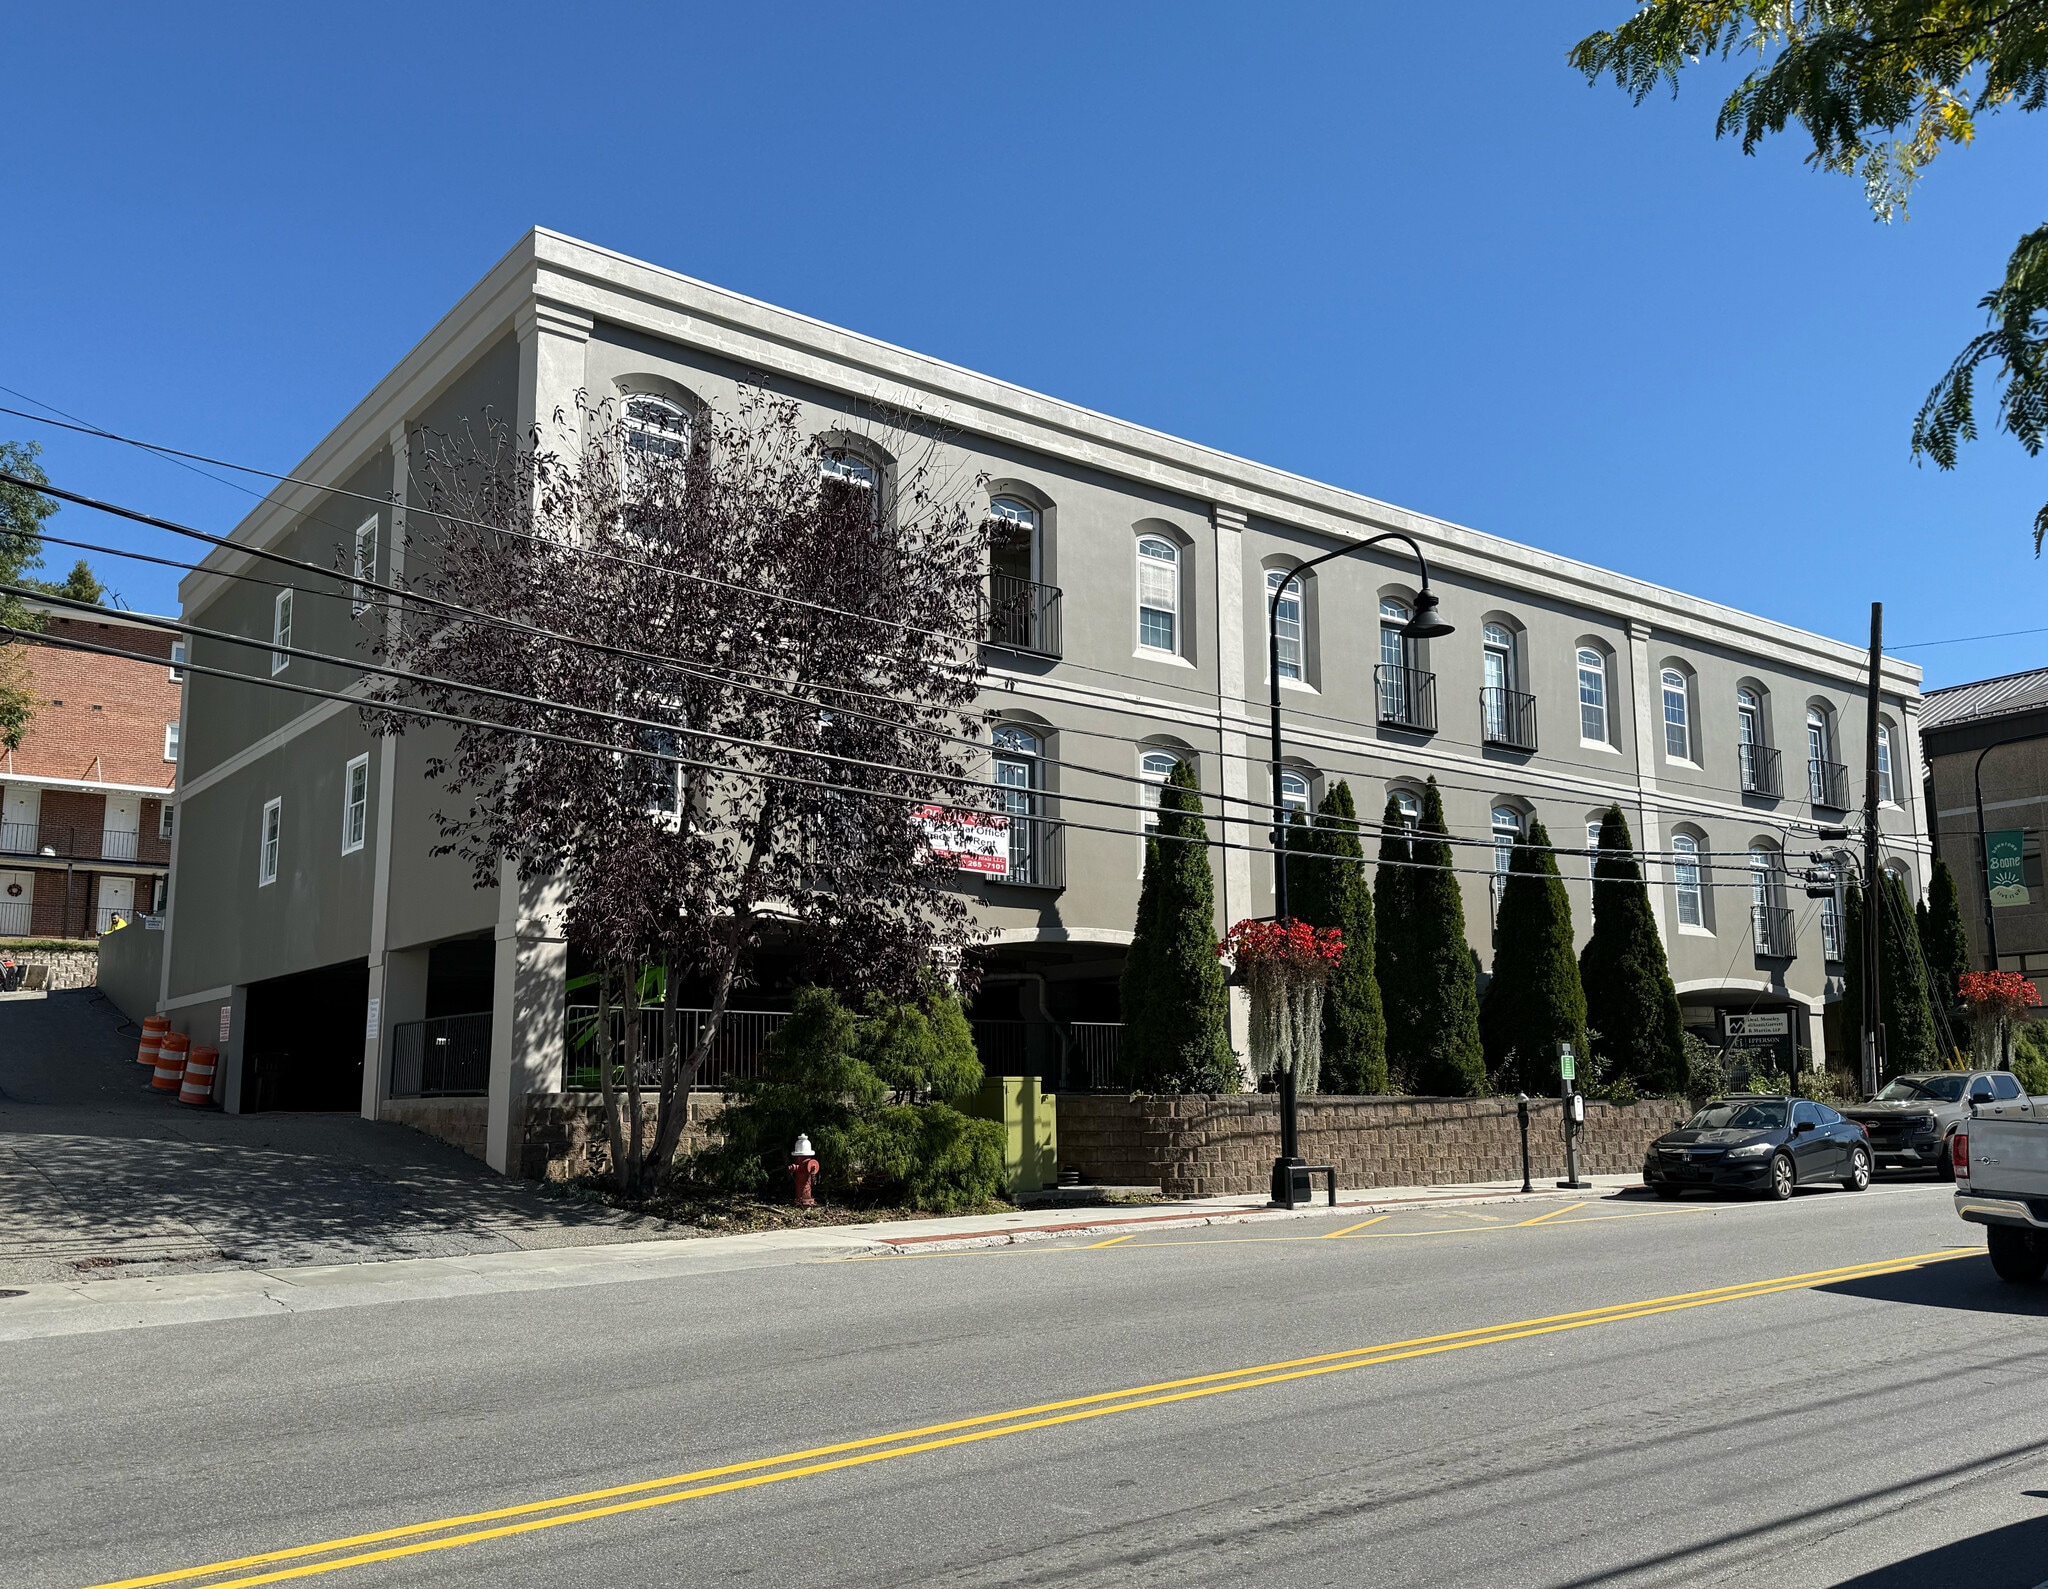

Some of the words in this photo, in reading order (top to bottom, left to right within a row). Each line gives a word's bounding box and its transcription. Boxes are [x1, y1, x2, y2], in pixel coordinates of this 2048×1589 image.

[976, 827, 1006, 838] Office
[973, 836, 996, 847] Rent
[967, 861, 983, 869] 265
[1990, 856, 2021, 869] Boone
